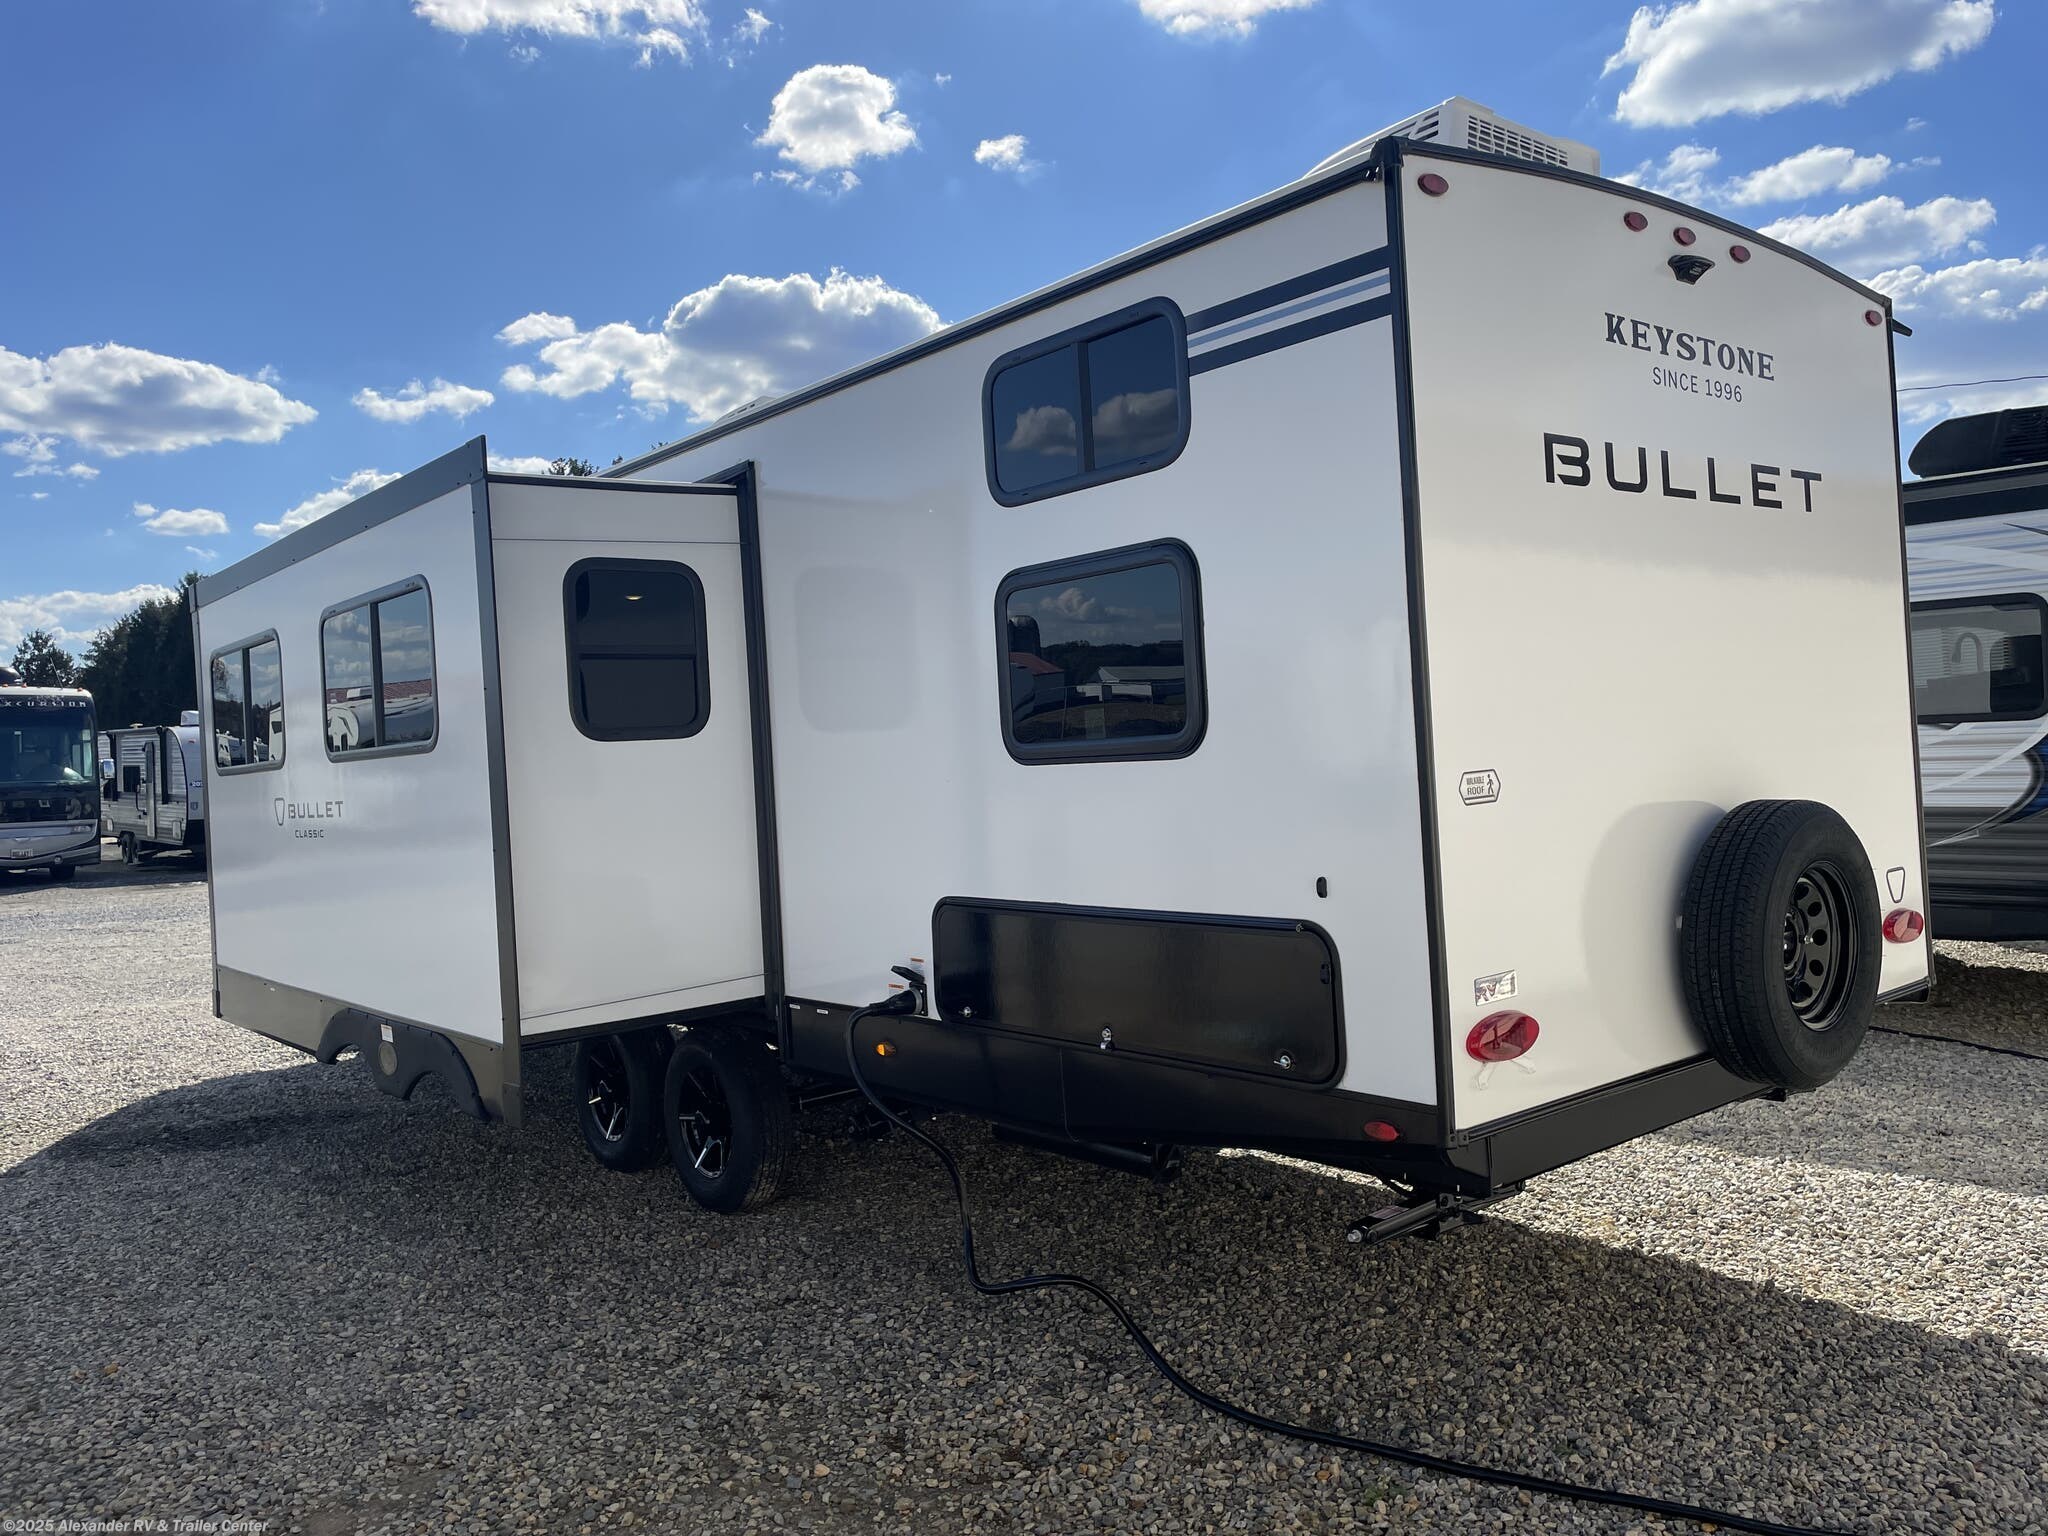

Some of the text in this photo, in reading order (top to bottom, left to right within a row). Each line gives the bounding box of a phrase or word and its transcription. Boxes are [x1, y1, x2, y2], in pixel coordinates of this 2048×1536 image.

[1604, 312, 1775, 381] KEYSTONE
[1652, 366, 1743, 403] SINCE 1996
[1543, 432, 1822, 513] BULLET
[1467, 785, 1485, 796] ROOF
[287, 800, 344, 819] BULLET
[294, 829, 325, 839] CLASSIC
